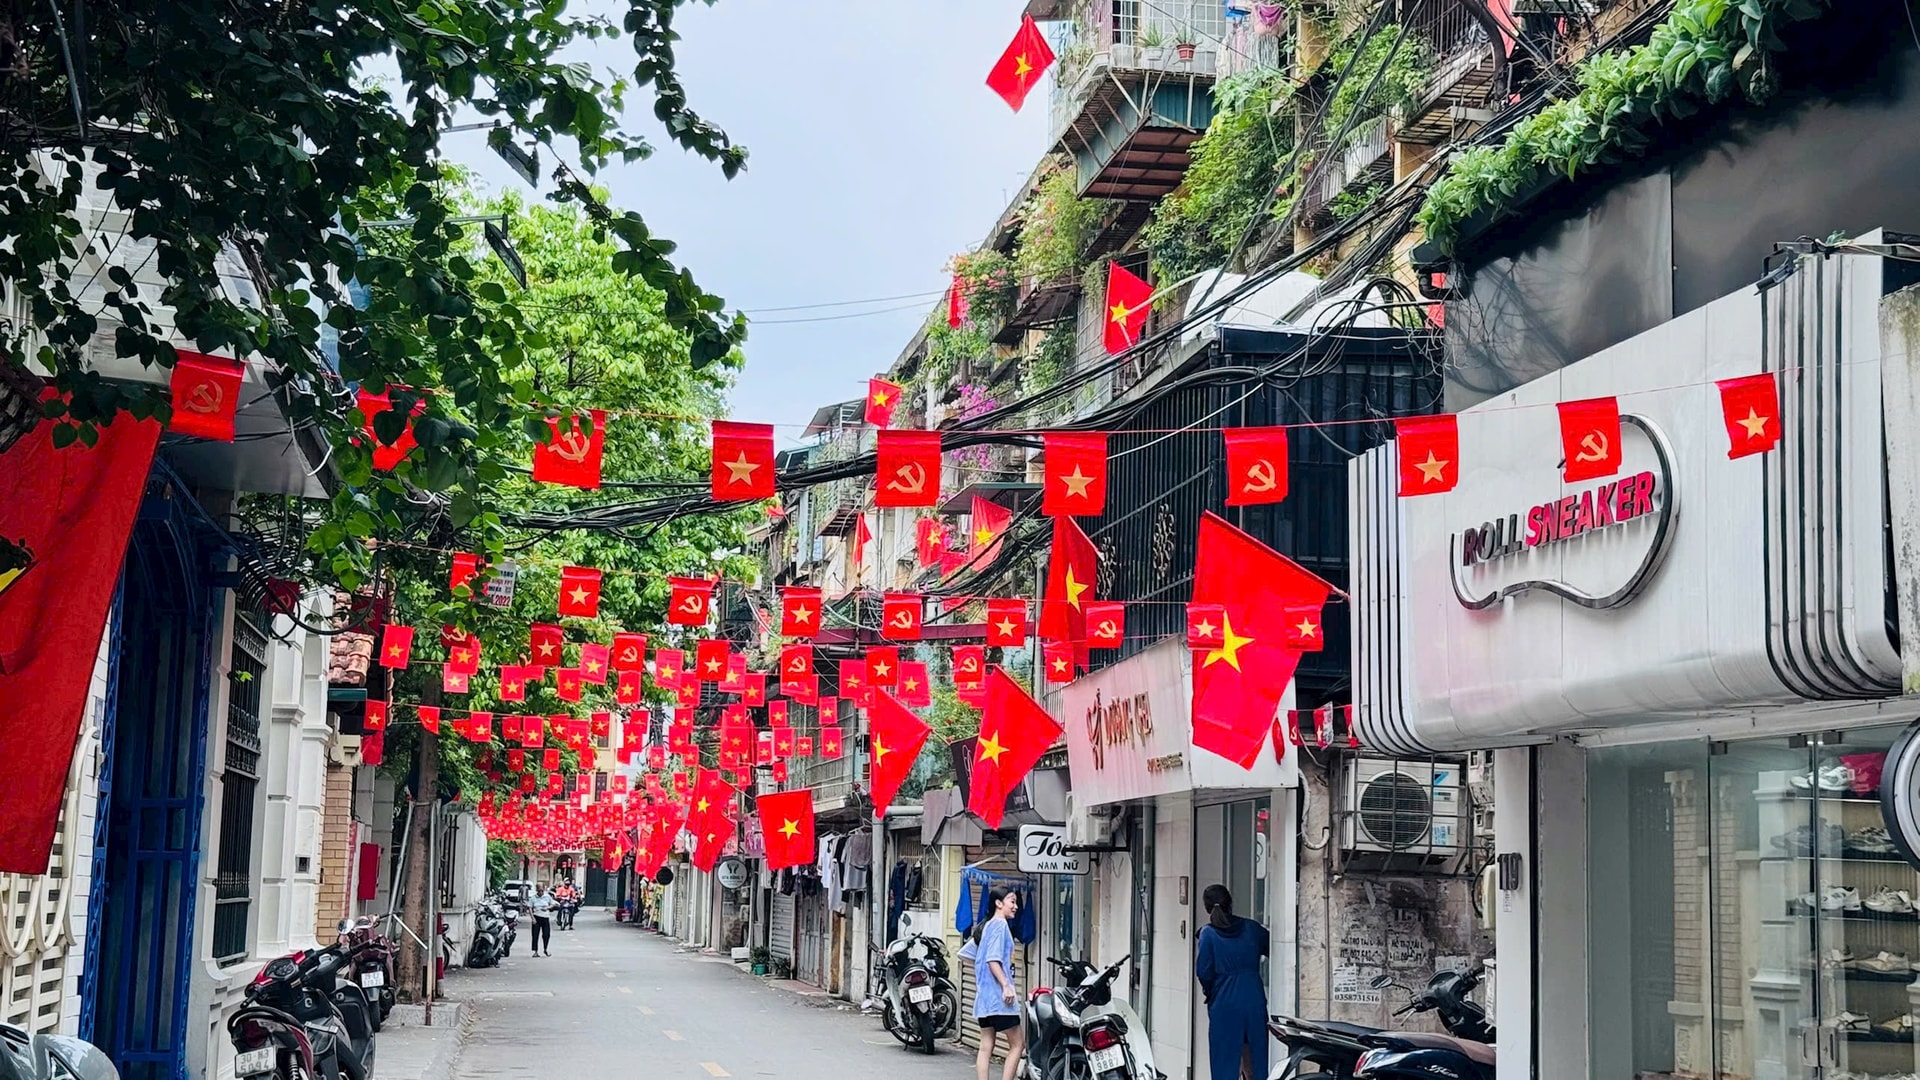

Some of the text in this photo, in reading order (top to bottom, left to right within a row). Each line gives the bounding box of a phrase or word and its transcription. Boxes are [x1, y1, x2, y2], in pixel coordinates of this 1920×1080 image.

[1463, 471, 1656, 566] ROLL SNEAKER
[1037, 862, 1058, 870] NAM
[1334, 993, 1379, 1002] 0358731516
